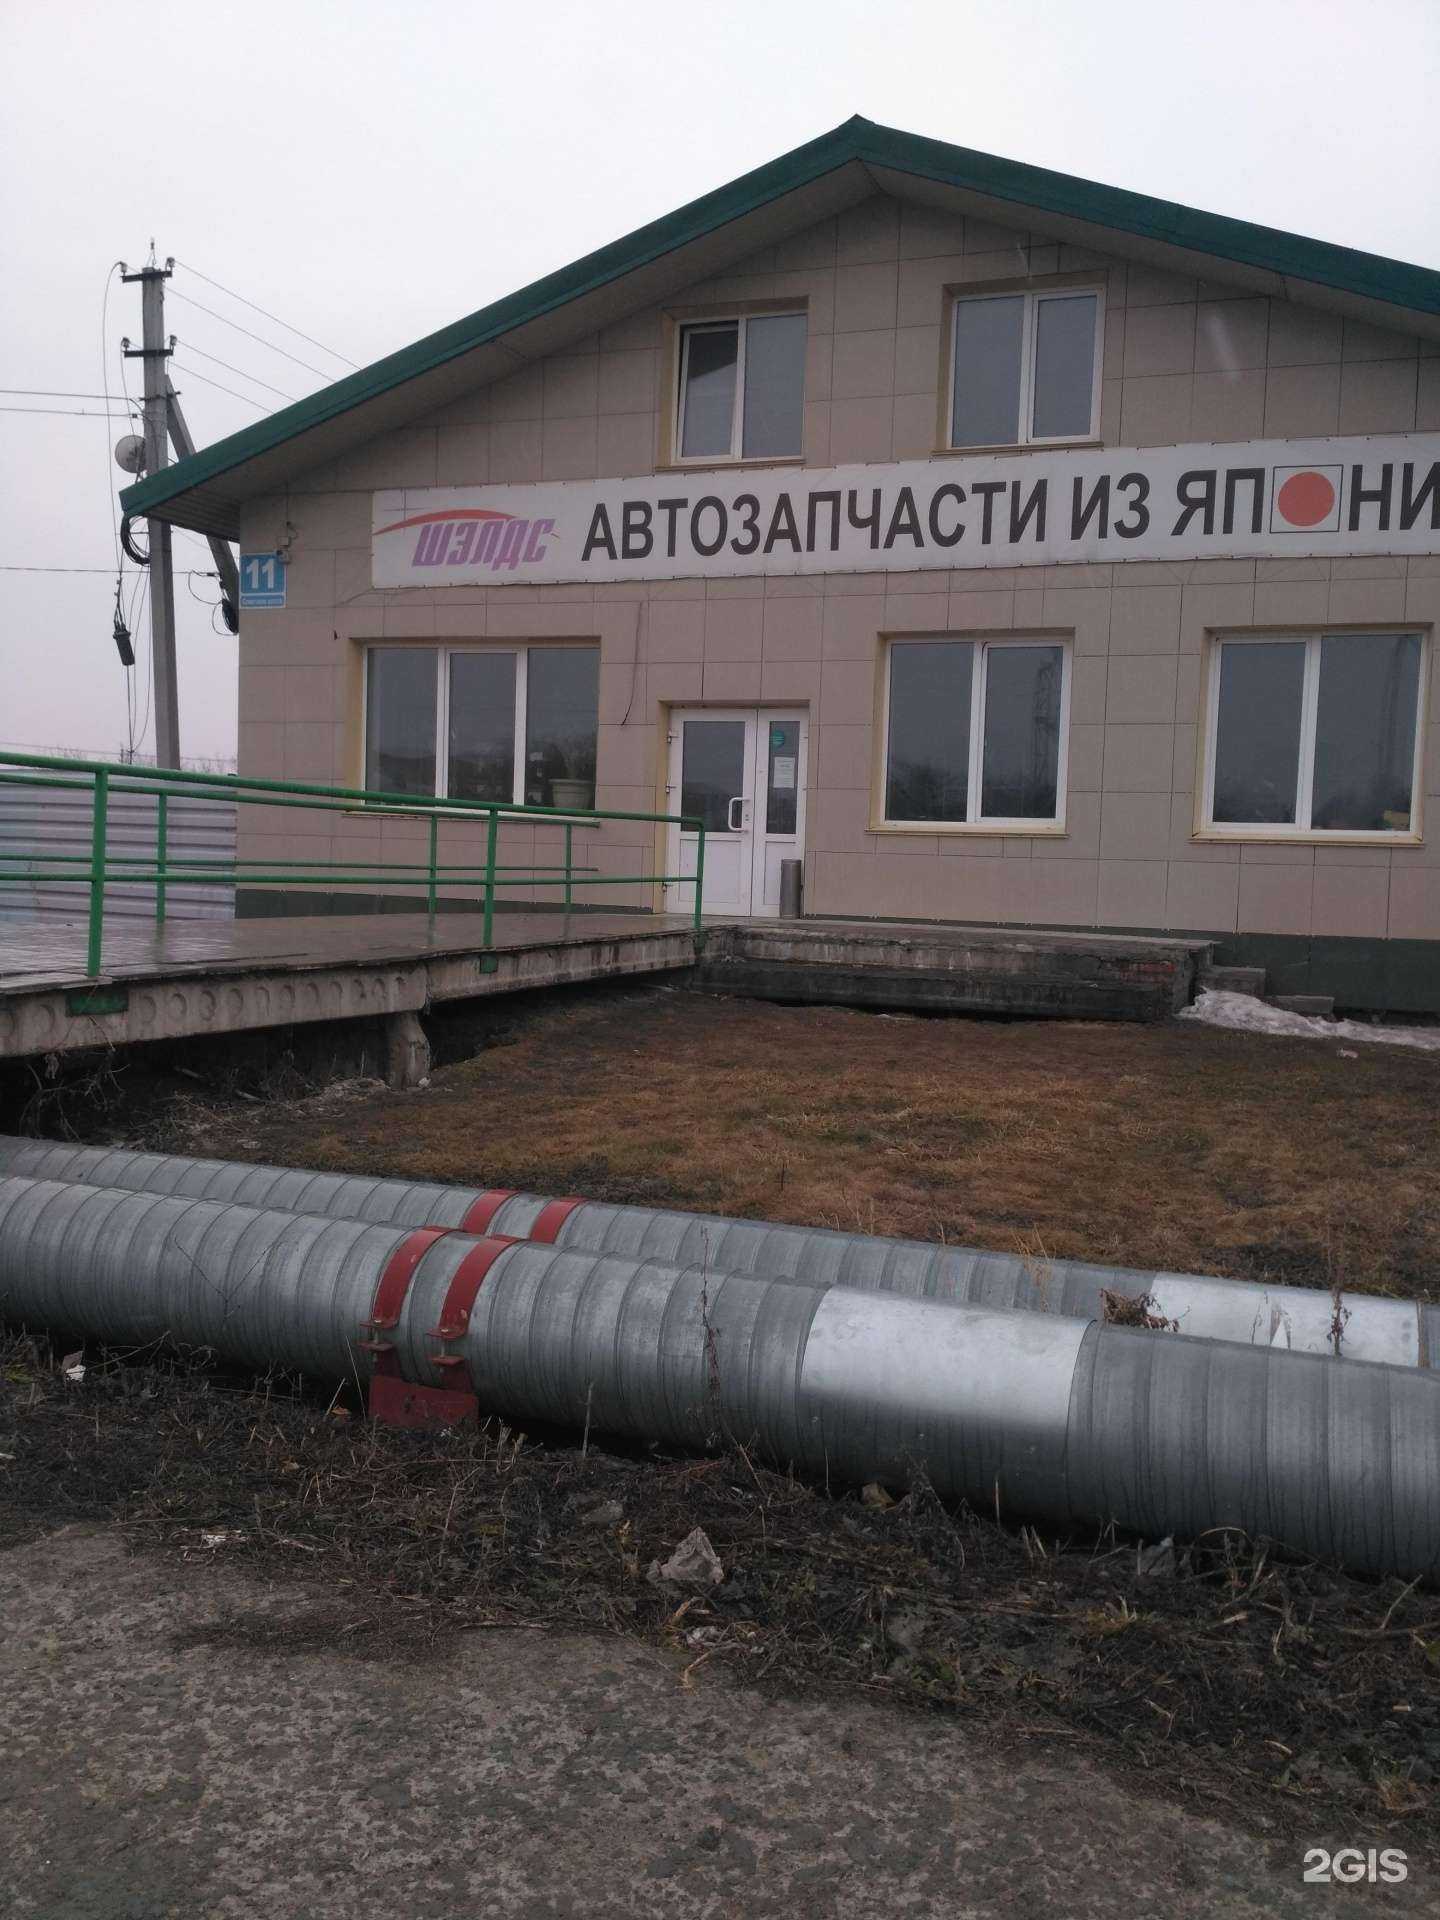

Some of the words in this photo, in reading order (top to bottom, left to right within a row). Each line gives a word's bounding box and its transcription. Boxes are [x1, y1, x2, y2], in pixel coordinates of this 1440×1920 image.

[581, 478, 1048, 561] АВТОЗАПЧАСТИ
[1070, 472, 1151, 539] ИЗ
[246, 559, 274, 589] 11
